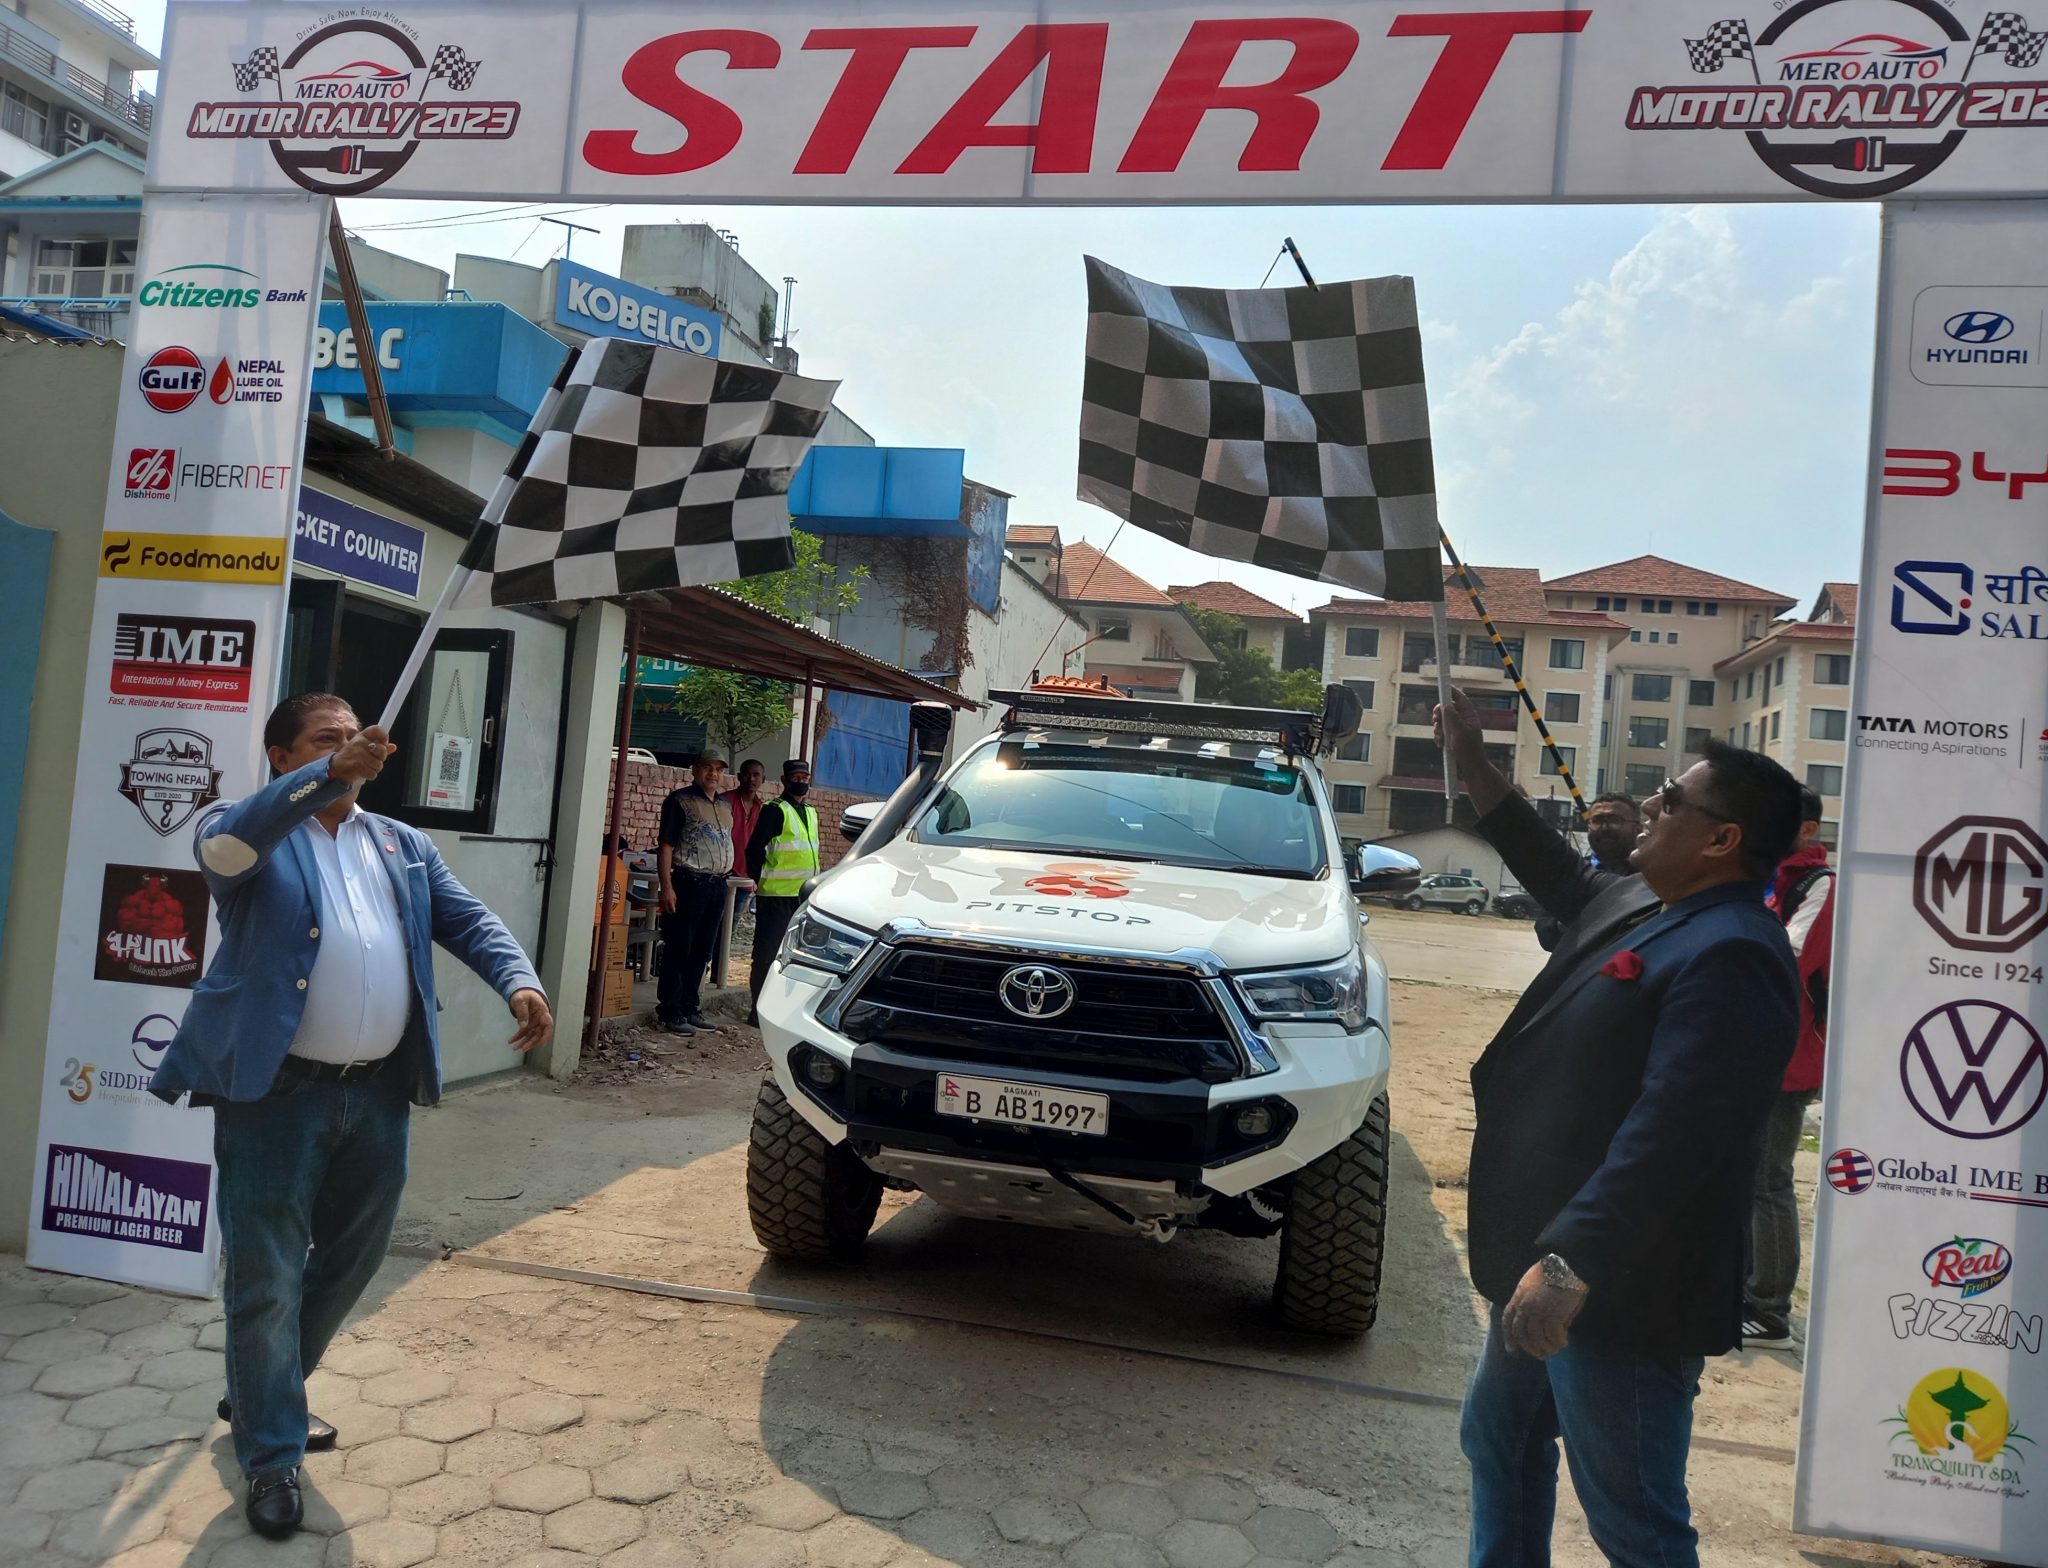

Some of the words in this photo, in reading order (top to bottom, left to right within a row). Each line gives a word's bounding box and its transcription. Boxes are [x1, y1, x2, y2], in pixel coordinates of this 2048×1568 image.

[295, 23, 317, 41] Drive
[319, 14, 336, 26] Safe
[361, 6, 381, 19] Enjoy
[384, 11, 420, 41] Afterwards
[583, 9, 1593, 175] START
[190, 104, 298, 136] MOTOR
[303, 104, 415, 136] RALLY
[416, 104, 518, 136] 2023
[1629, 89, 1789, 127] MOTOR
[1796, 88, 1962, 126] RALLY
[139, 280, 261, 308] Citizens
[265, 289, 308, 303] Bank
[567, 277, 713, 356] KOBELCO
[314, 327, 405, 370] BEC
[1926, 348, 2028, 364] HYUNDAI
[142, 369, 203, 390] Gulf
[238, 360, 285, 374] NEPAL
[236, 377, 263, 387] LUBE
[266, 378, 284, 388] OIL
[234, 391, 283, 402] LIMITED
[181, 463, 291, 490] FIBERNET
[124, 489, 171, 501] DishHome
[140, 546, 280, 572] Foodmandu
[344, 529, 419, 574] COUNTER
[134, 626, 244, 668] IME
[122, 674, 176, 686] International
[176, 677, 204, 689] Money
[206, 679, 239, 691] Express
[108, 696, 126, 706] Fast,
[128, 698, 159, 708] Reliable
[160, 700, 174, 709] And
[176, 701, 202, 711] Secure
[204, 702, 248, 713] Remittance
[1857, 715, 1916, 734] TATA
[1923, 719, 2008, 740] MOTORS
[1855, 735, 1929, 755] Connecting
[1931, 741, 2007, 757] Aspirations
[131, 770, 173, 784] TOWING
[176, 774, 208, 786] NEPAL
[1931, 832, 2043, 936] MG
[965, 901, 1151, 926] PITSTOP
[1928, 956, 1983, 979] Since
[1994, 962, 2044, 984] 1924
[966, 1090, 982, 1114] B
[1003, 1086, 1041, 1098] BAGMATI
[50, 1149, 202, 1227] HIMALAYAN
[1877, 1158, 1958, 1185] Global
[1969, 1166, 2024, 1192] IME
[56, 1212, 111, 1234] PREMIUM
[114, 1220, 151, 1240] LAGER
[153, 1225, 183, 1245] BEER
[1931, 1243, 2005, 1288] Real
[1963, 1279, 1989, 1297] Fruit
[1888, 1292, 2043, 1354] FIZZIN
[1892, 1452, 1987, 1479] TRANQUILITY
[1988, 1466, 2021, 1485] SPA
